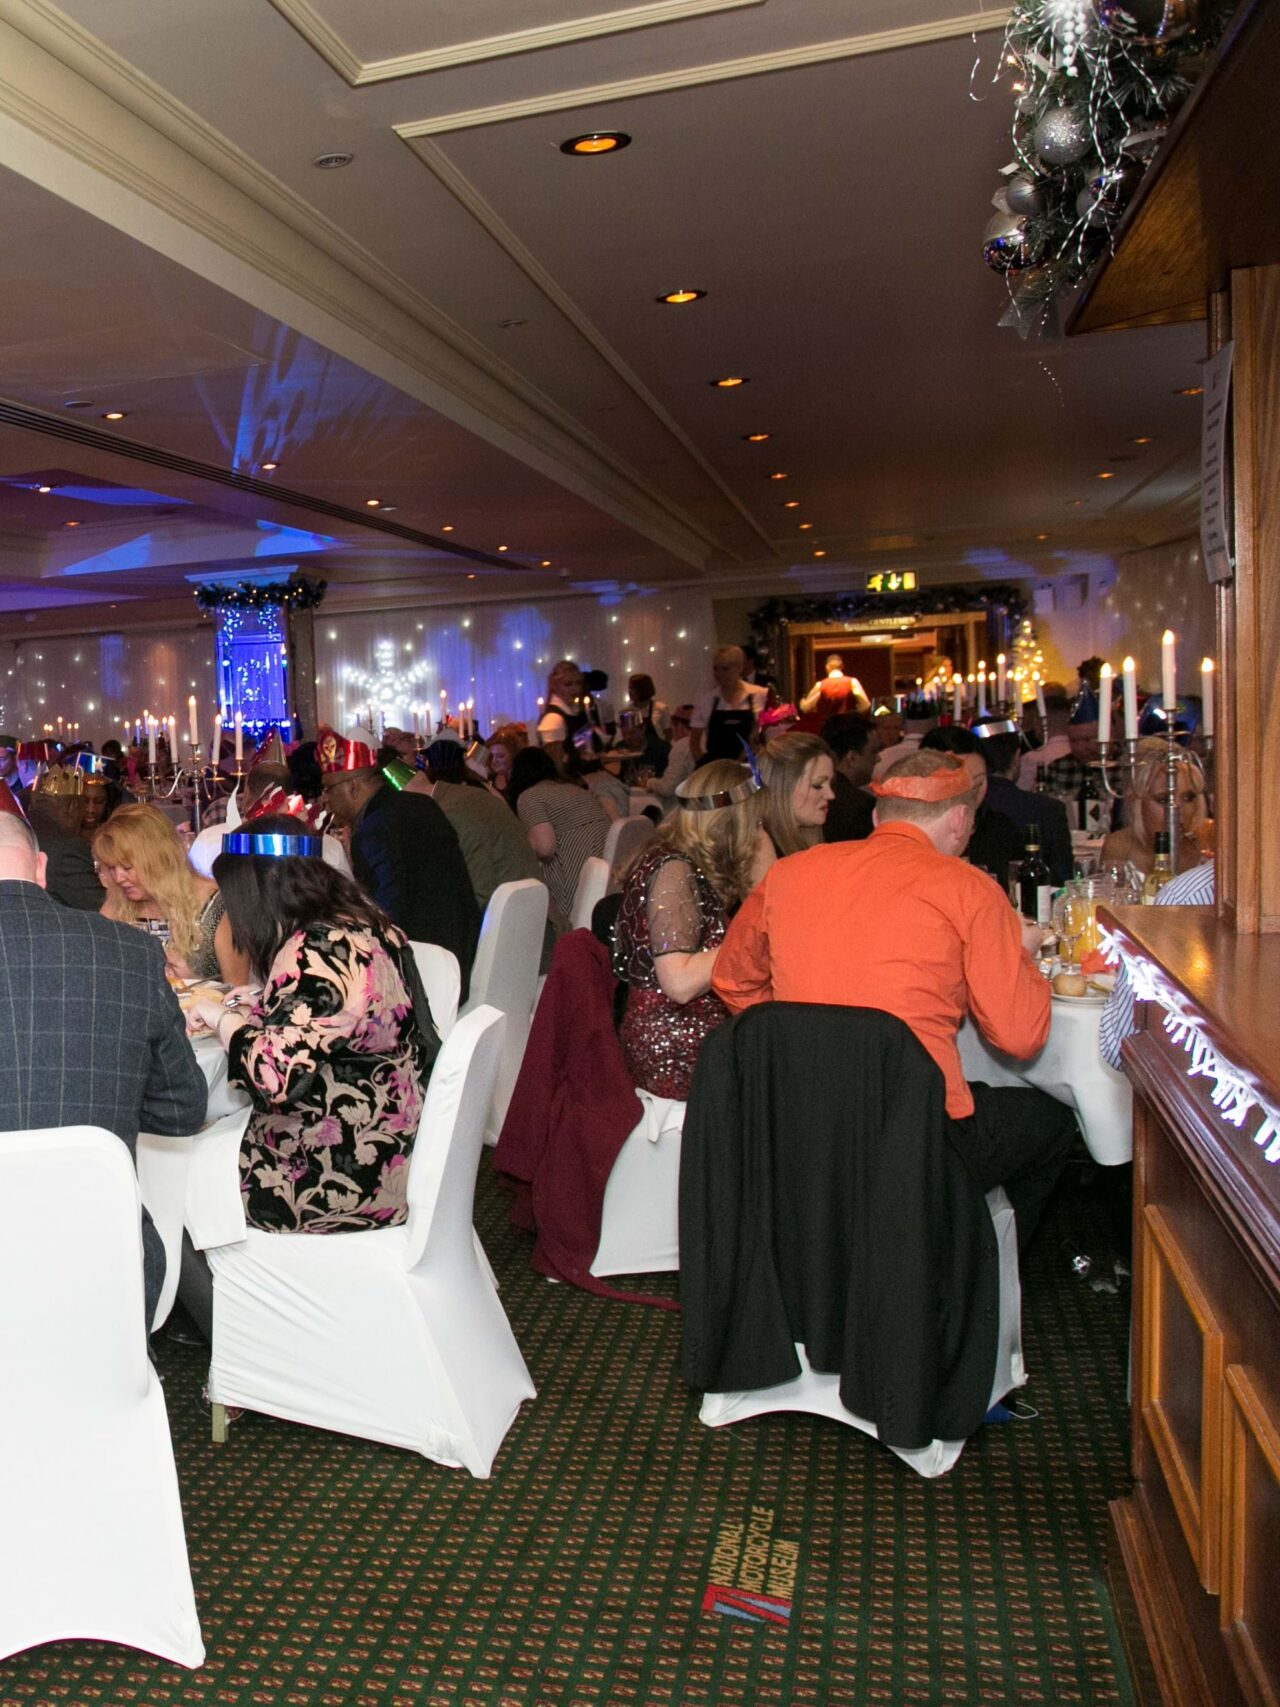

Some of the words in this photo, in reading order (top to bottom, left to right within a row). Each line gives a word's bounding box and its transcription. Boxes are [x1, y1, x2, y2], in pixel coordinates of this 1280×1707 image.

[707, 1522, 744, 1587] NATIONAL
[736, 1505, 774, 1594] MOTORCYCLE
[766, 1538, 800, 1600] MUSEUM
